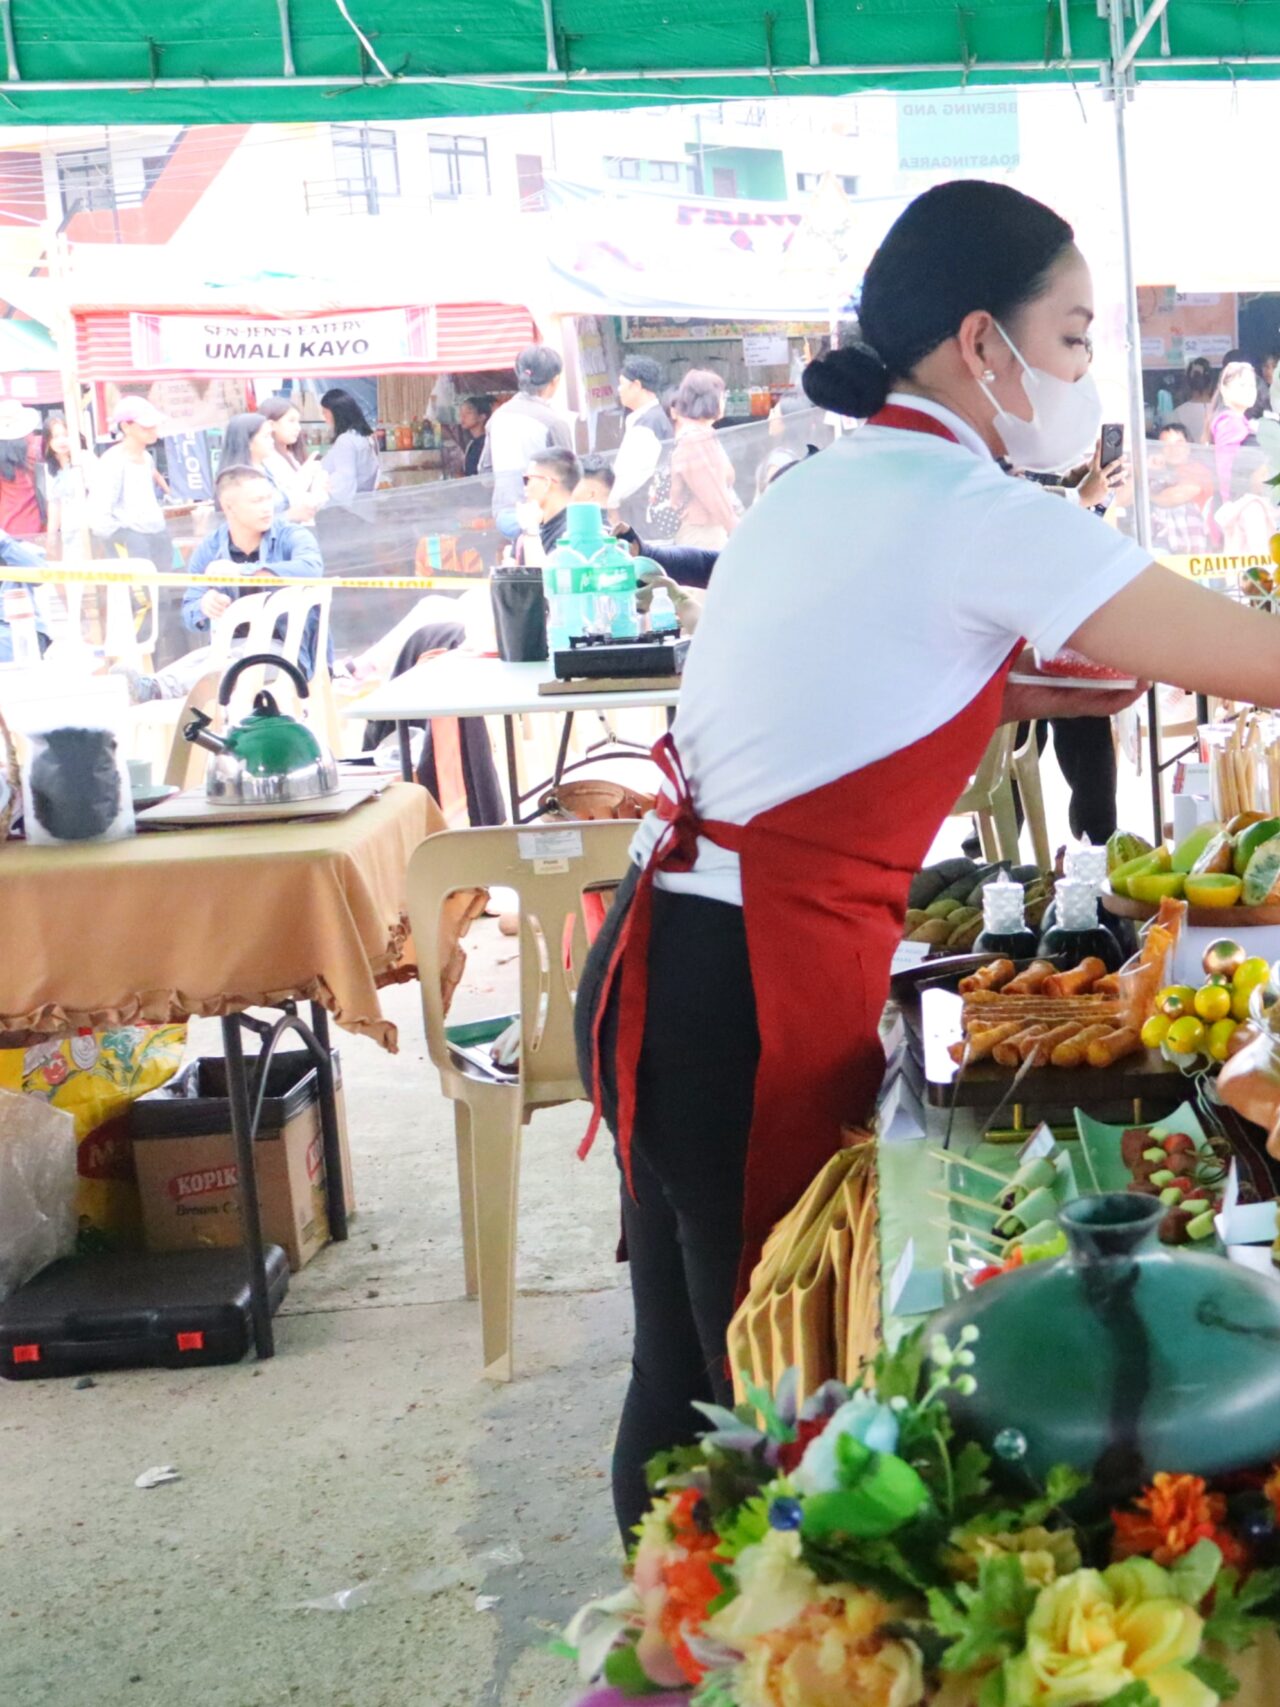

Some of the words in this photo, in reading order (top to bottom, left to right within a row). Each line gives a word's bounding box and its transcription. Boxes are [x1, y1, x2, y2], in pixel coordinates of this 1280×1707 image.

[205, 343, 290, 359] UMALI
[300, 339, 369, 358] KAYO
[176, 1167, 239, 1195] KOPIK
